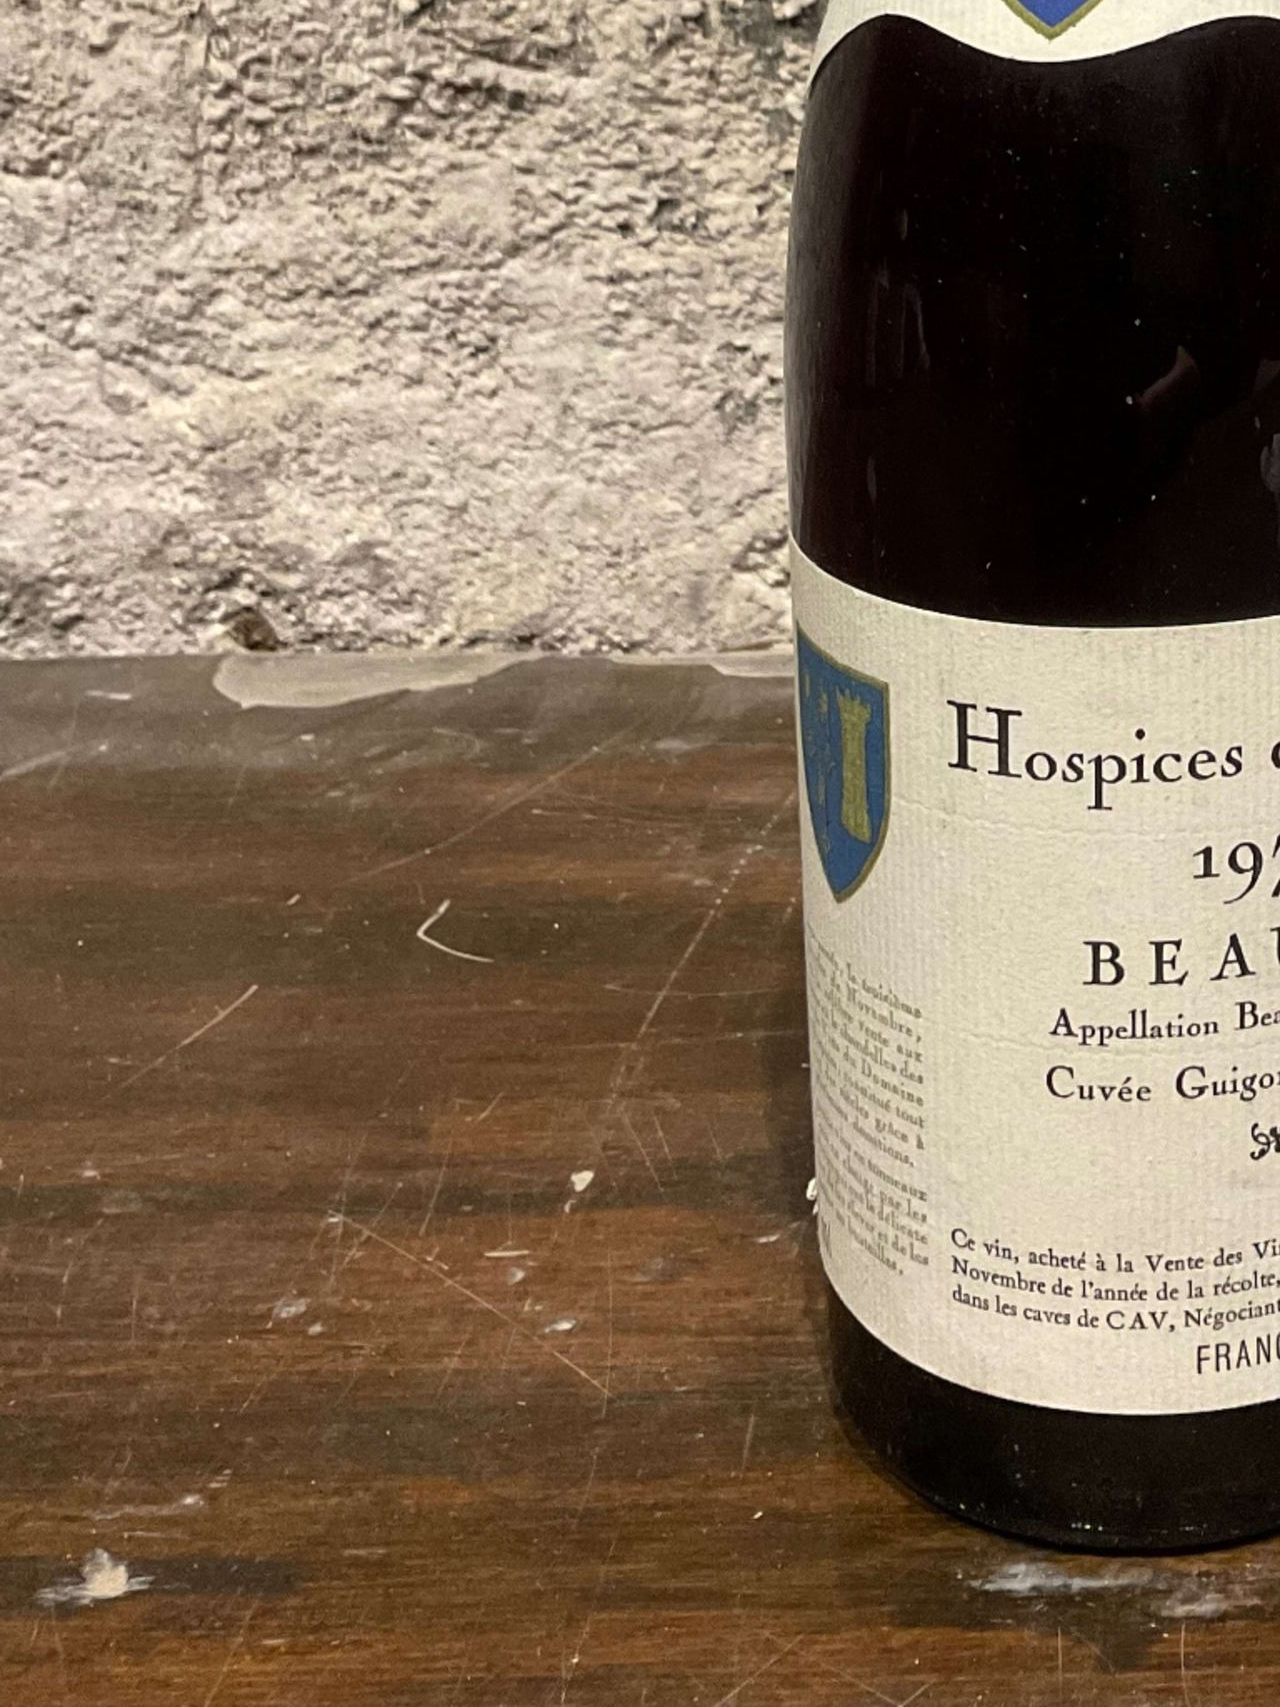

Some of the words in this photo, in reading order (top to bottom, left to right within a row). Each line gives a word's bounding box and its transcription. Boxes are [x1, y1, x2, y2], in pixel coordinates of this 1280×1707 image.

[946, 698, 1245, 811] Hospices
[1049, 1007, 1220, 1047] Appellation
[1046, 1064, 1152, 1103] Cuvée
[950, 1227, 976, 1251] Ce
[983, 1238, 1019, 1265] vin,
[1028, 1248, 1087, 1272] acheté
[1096, 1254, 1107, 1272] à
[1116, 1254, 1134, 1273] la
[1145, 1254, 1205, 1273] Vente
[1213, 1248, 1243, 1270] des
[951, 1255, 1047, 1295] Novembre
[1051, 1278, 1074, 1298] de
[1081, 1280, 1148, 1302] l'année
[1156, 1281, 1179, 1301] de
[1187, 1280, 1205, 1299] la
[1213, 1272, 1280, 1296] récolte,
[952, 1284, 989, 1311] dans
[995, 1295, 1017, 1317] les
[1023, 1307, 1071, 1326] caves
[1077, 1309, 1100, 1328] de
[1106, 1311, 1176, 1333] CAV,
